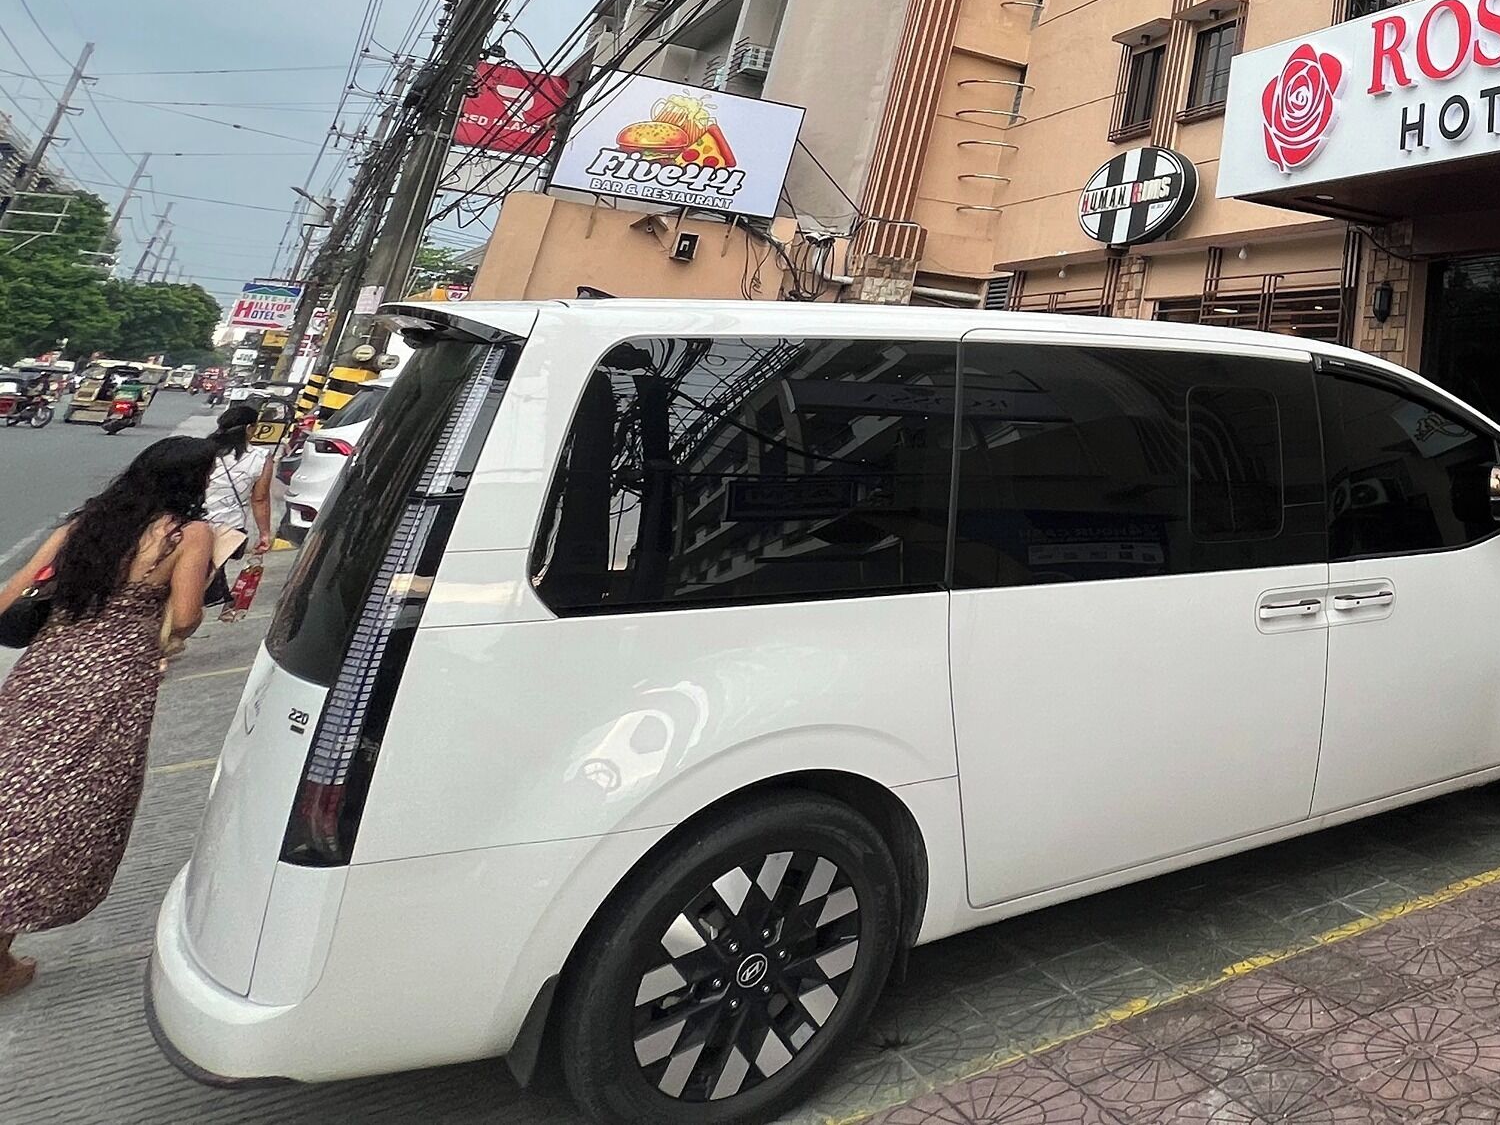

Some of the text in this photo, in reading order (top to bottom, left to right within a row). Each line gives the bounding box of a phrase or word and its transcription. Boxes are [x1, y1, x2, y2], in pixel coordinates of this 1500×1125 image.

[492, 117, 547, 135] PLANE
[585, 147, 747, 196] Five44
[590, 177, 734, 210] BAR & RESTAURANT
[1081, 184, 1127, 213] HUMAN
